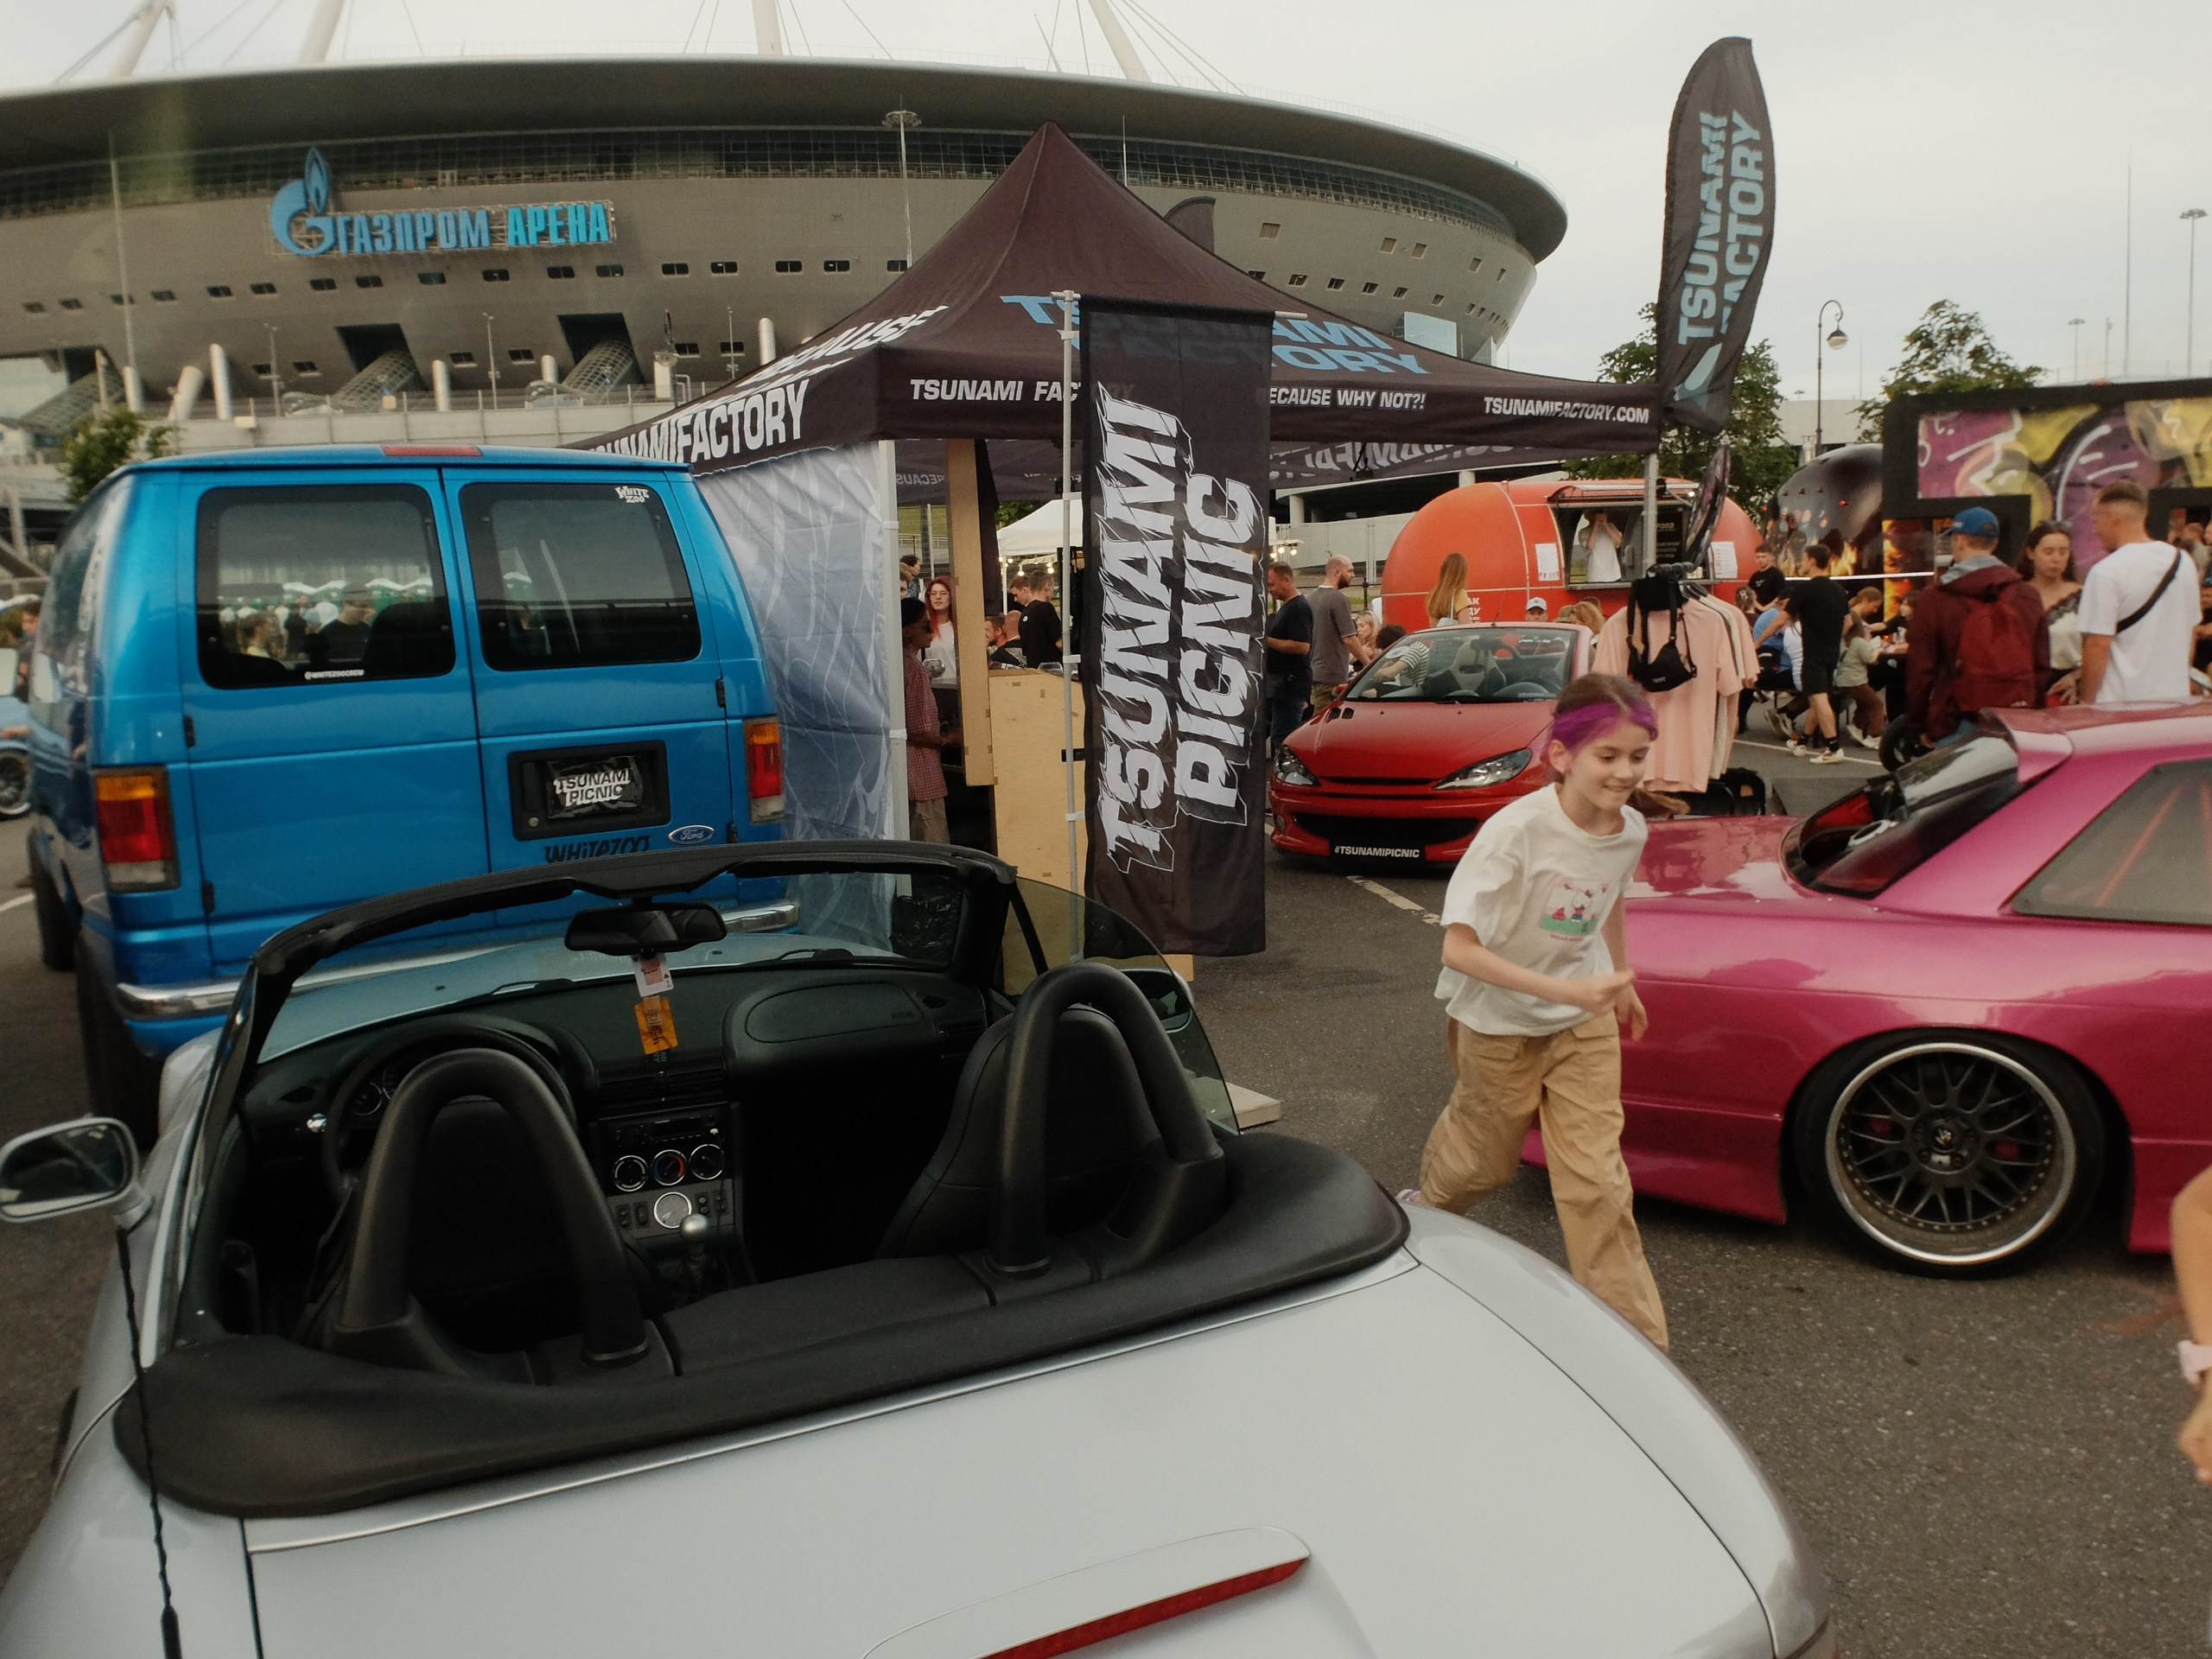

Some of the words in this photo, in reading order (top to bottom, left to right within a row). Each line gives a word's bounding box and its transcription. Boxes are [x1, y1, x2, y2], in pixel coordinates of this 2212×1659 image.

[337, 209, 491, 254] ГАЗПРОМ
[507, 202, 609, 246] АРЕНА
[1678, 111, 1727, 345] TSUNAMI
[910, 379, 1024, 402] TSUNAMI
[1270, 387, 1332, 406] ECAUSE
[1338, 390, 1376, 407] WHY
[1380, 391, 1427, 410] NOT?!
[1484, 397, 1649, 424] TSUNAMIFACTORY.COM
[614, 486, 650, 499] WHITE
[1096, 382, 1185, 871] TSUNAMI
[1174, 473, 1264, 825] PICNIC
[553, 768, 631, 794] TSUNAMI
[565, 783, 623, 807] PICNIC
[680, 829, 704, 841] Ford
[1334, 845, 1421, 858] #TSUNAMIPICNIC
